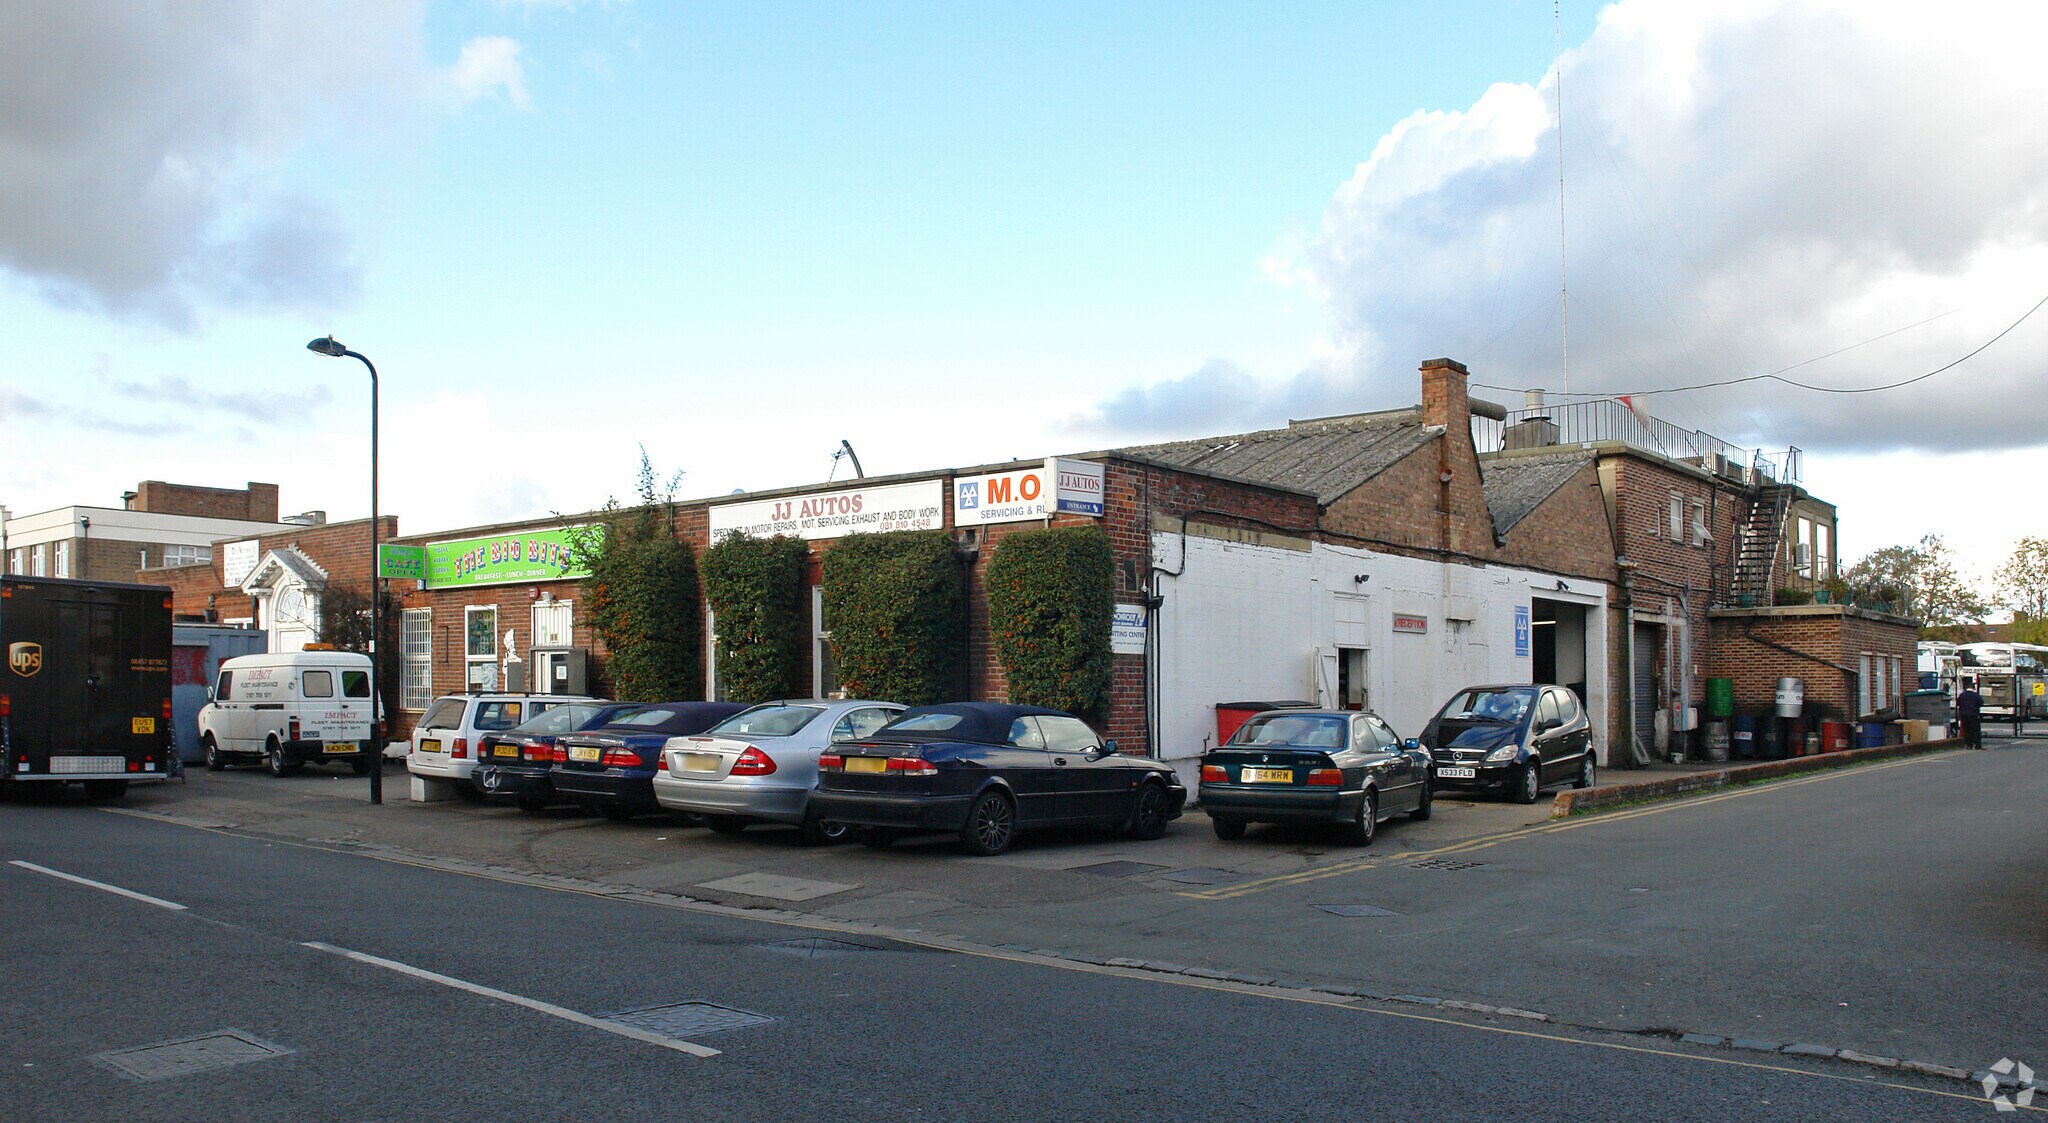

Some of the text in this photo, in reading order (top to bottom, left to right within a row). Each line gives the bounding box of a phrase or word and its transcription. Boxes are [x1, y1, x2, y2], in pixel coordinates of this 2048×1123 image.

[1072, 477, 1100, 490] AUTOS
[771, 494, 863, 521] JJ AUTOS
[980, 507, 1025, 519] SERVICING
[1027, 506, 1033, 515] &
[752, 523, 772, 534] MOTOR
[852, 512, 881, 524] EXHAUST
[883, 511, 897, 522] AND
[899, 509, 917, 520] BODY
[919, 507, 940, 518] WORK
[880, 522, 893, 531] 081
[454, 539, 572, 578] THE BIG BITE
[388, 568, 417, 576] OPEN
[475, 568, 546, 581] BREAKFAST LUNCH DINNER
[1397, 617, 1426, 629] RECEPTION
[12, 652, 40, 672] ups
[248, 669, 273, 680] IMPACT
[1271, 770, 1289, 780] WRW
[1459, 769, 1473, 777] FLD
